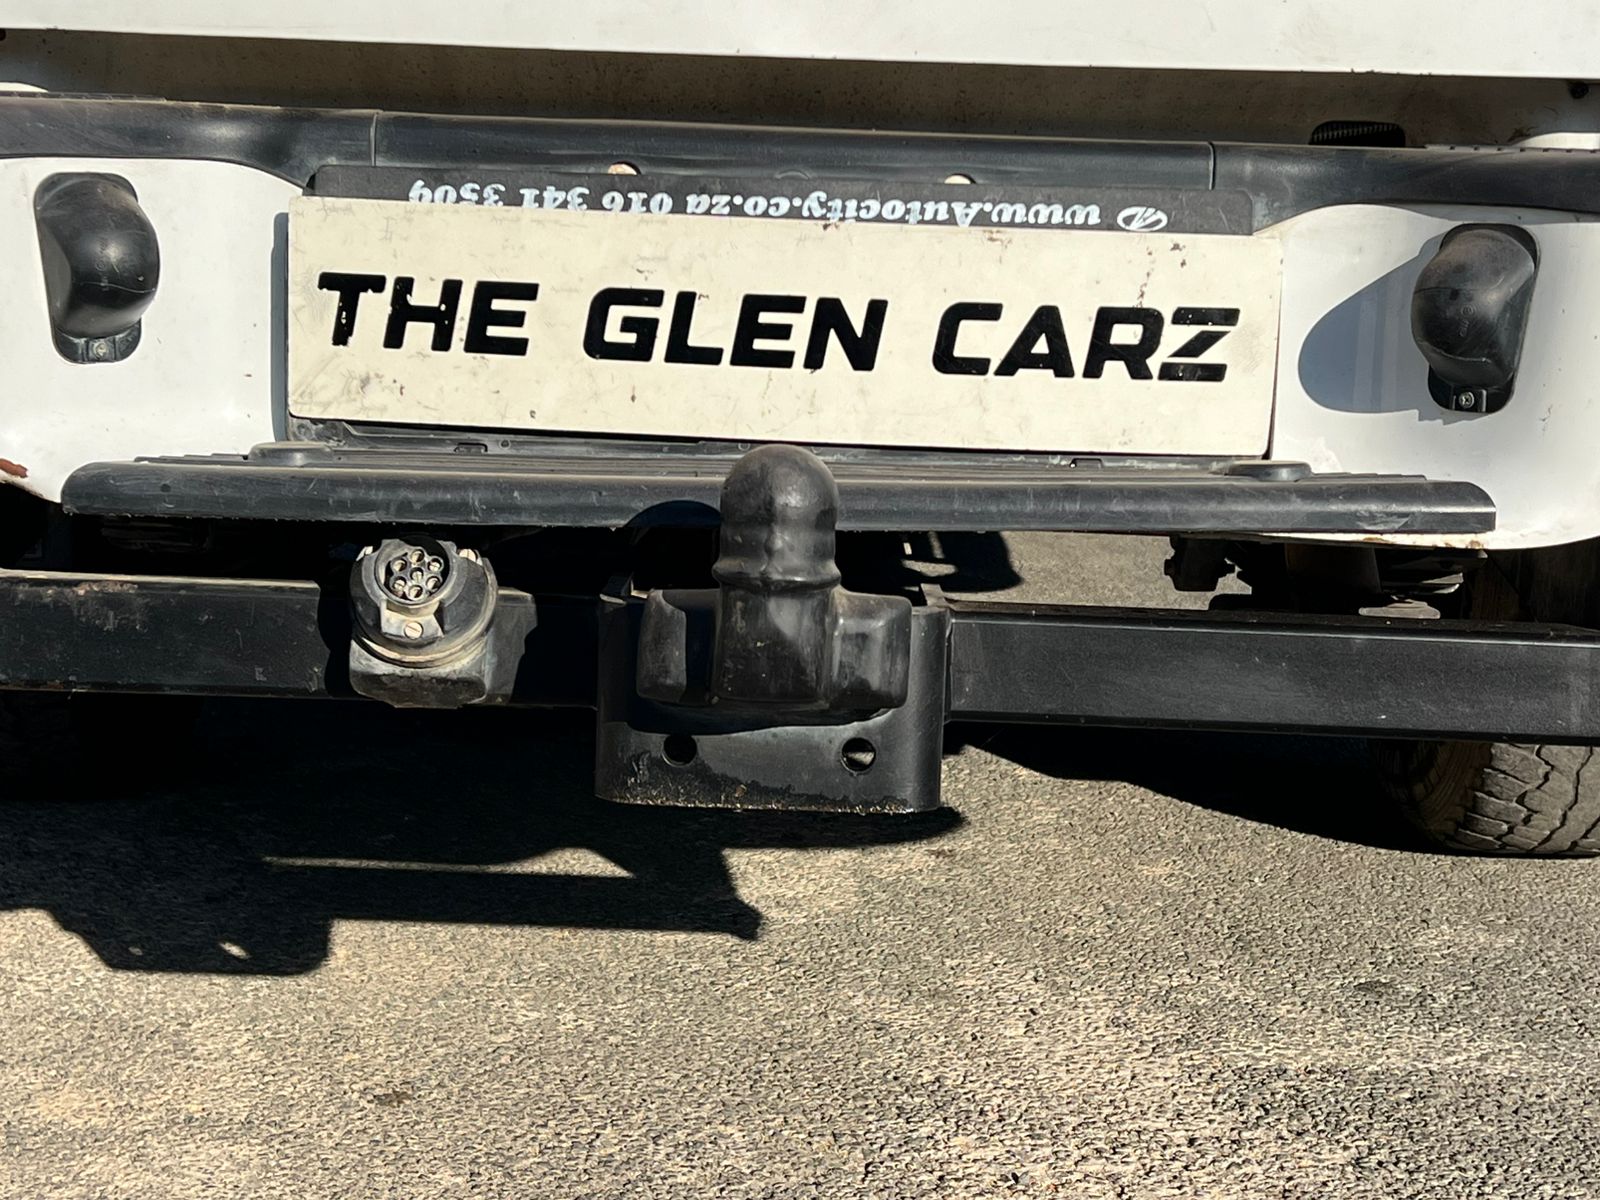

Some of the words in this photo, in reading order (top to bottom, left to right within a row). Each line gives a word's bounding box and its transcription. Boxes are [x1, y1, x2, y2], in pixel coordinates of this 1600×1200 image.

[519, 186, 590, 211] 341
[602, 191, 673, 214] 016
[686, 190, 1101, 228] www.Autocity.co.za
[317, 272, 540, 356] THE
[583, 287, 889, 372] GLEN
[932, 302, 1240, 382] CARZ
